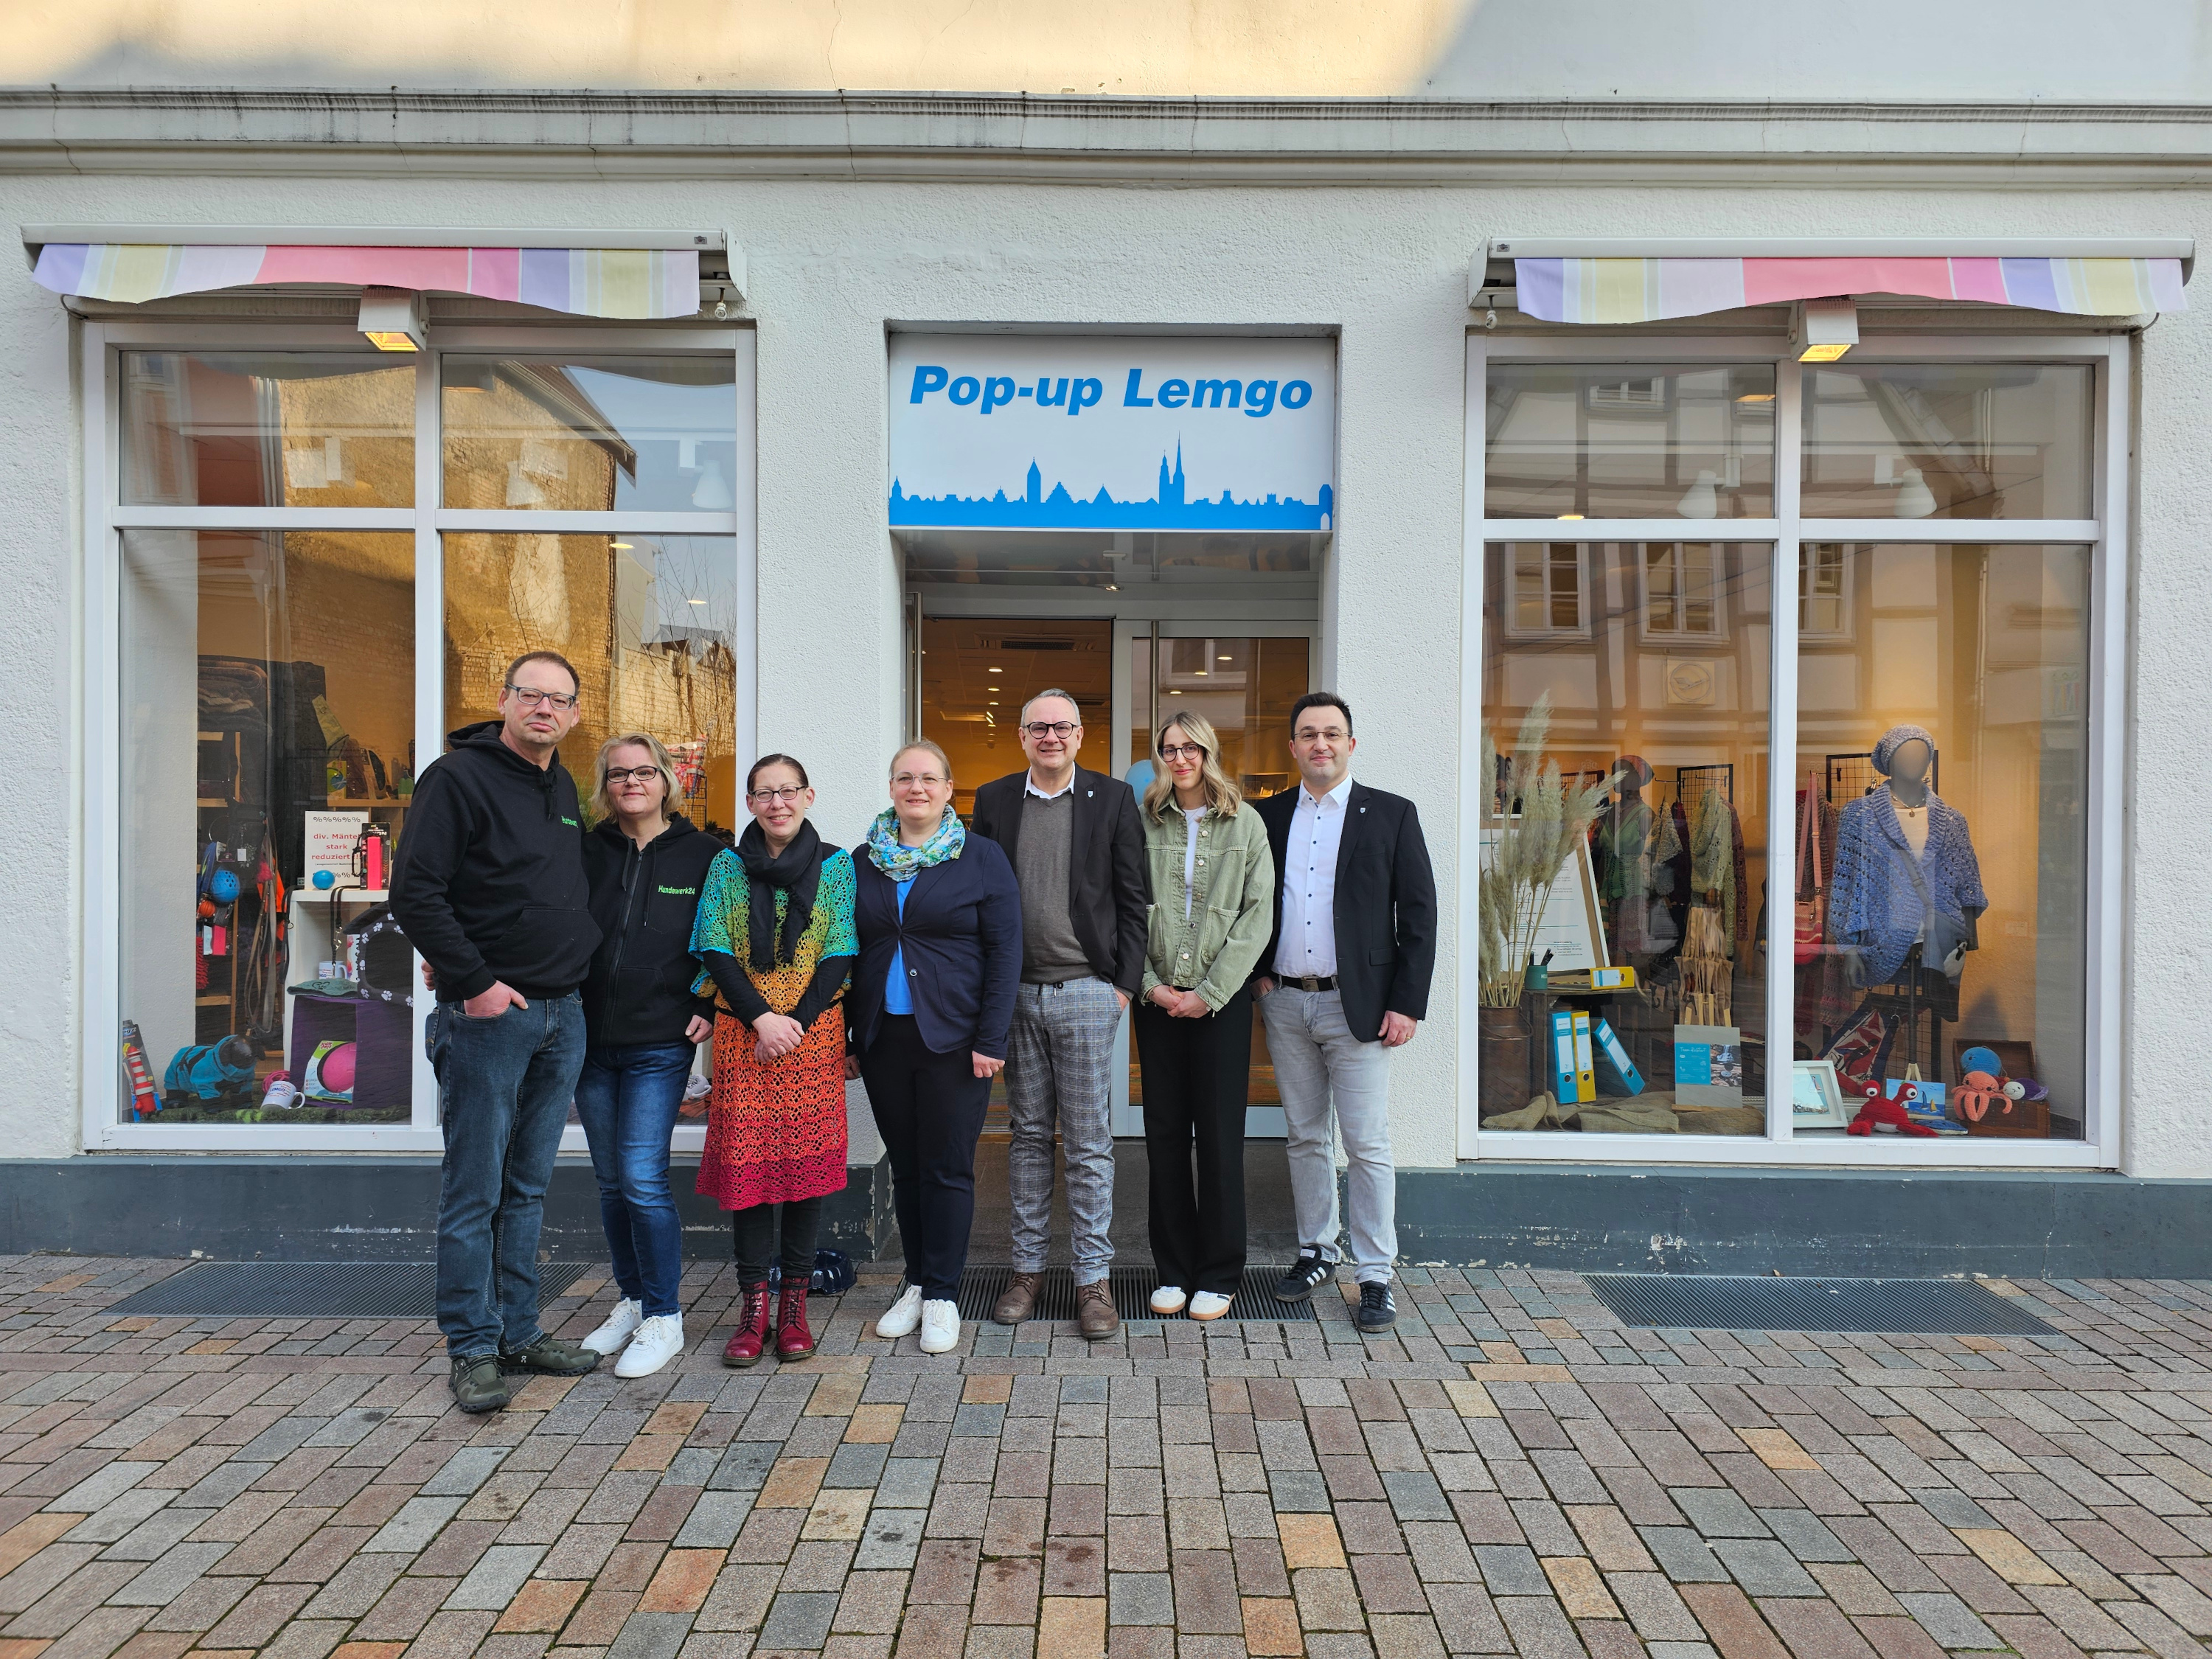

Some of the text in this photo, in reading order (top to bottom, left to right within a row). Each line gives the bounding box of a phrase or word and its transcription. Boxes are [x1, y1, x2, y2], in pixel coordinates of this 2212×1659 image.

[909, 365, 1312, 417] Pop-up Lemgo
[658, 885, 696, 895] Hundewerk24
